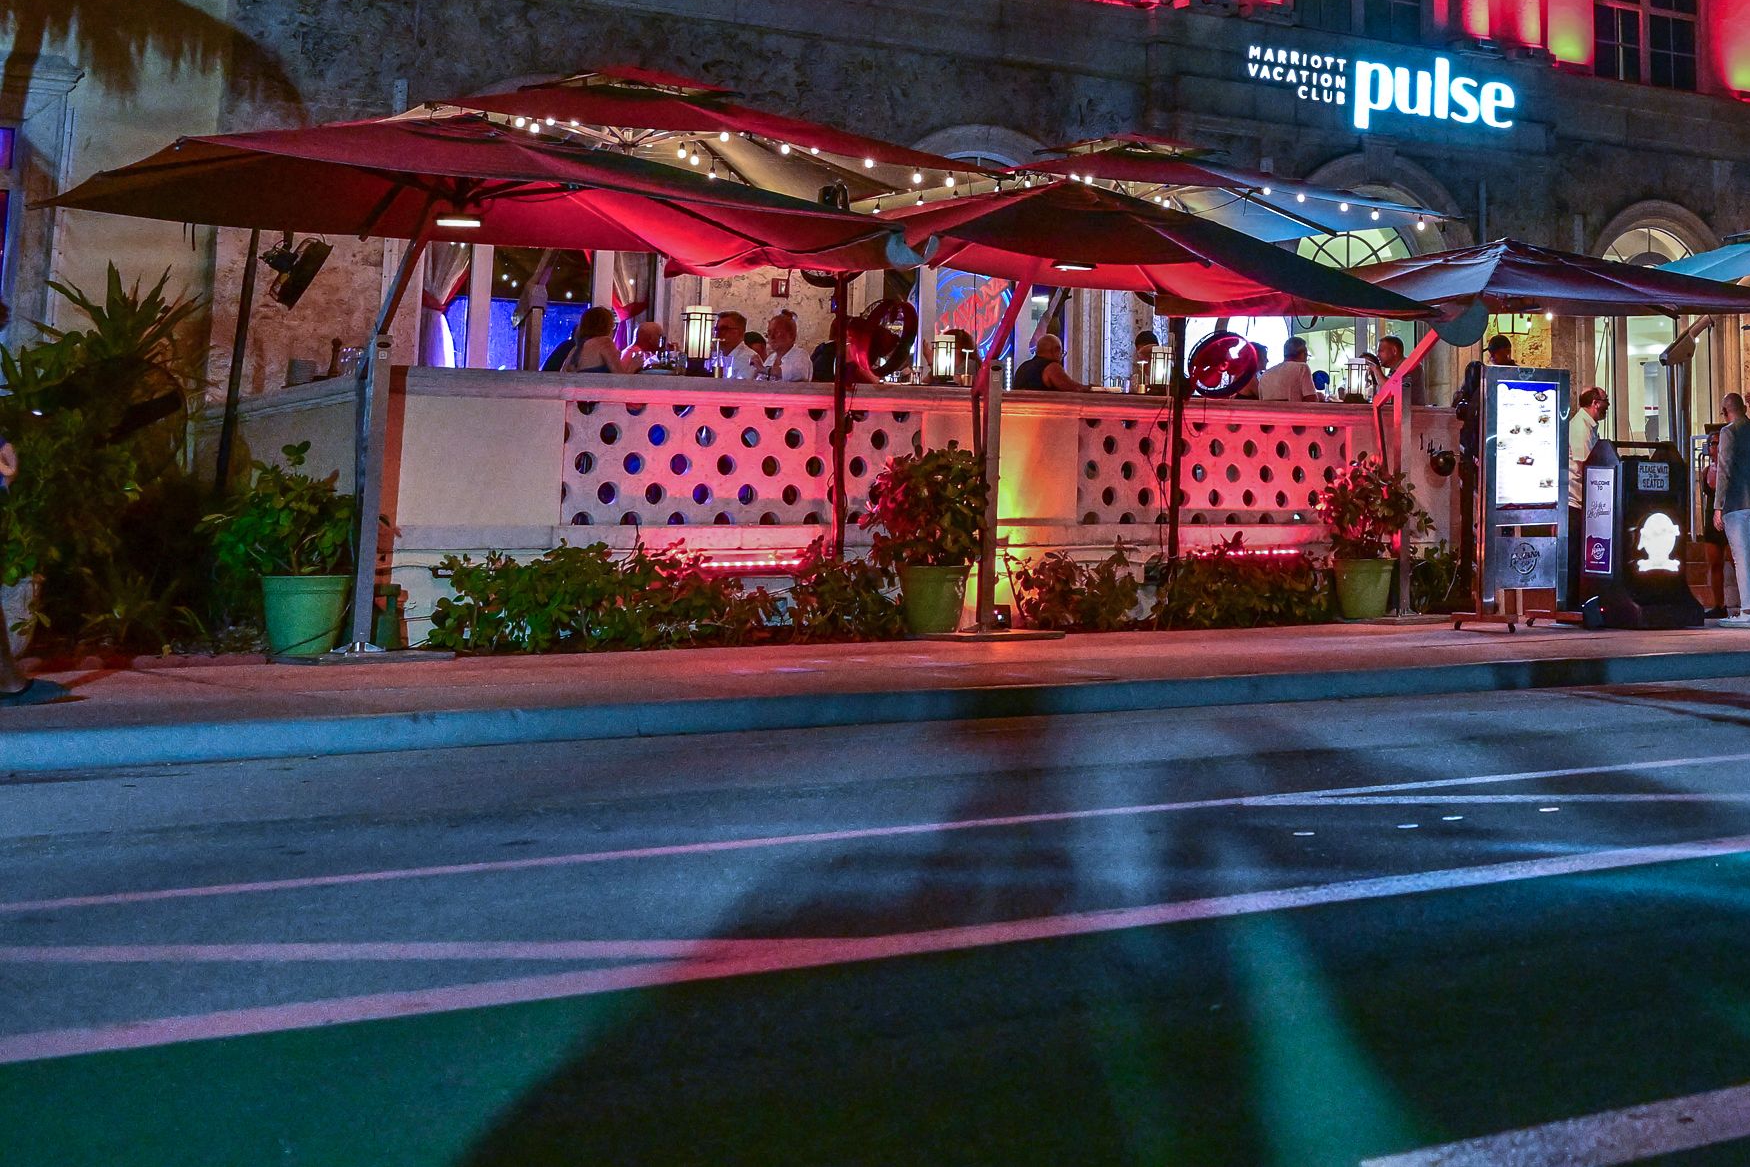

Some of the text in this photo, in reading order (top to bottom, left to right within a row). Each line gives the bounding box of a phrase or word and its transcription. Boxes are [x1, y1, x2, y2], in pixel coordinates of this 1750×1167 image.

[1249, 45, 1347, 72] MARRIOTT
[1248, 63, 1347, 89] VACATION
[1297, 87, 1347, 105] CLUB
[1354, 57, 1515, 129] pulse
[1639, 465, 1668, 474] PLEASE WAIT
[1642, 478, 1664, 488] SEATED
